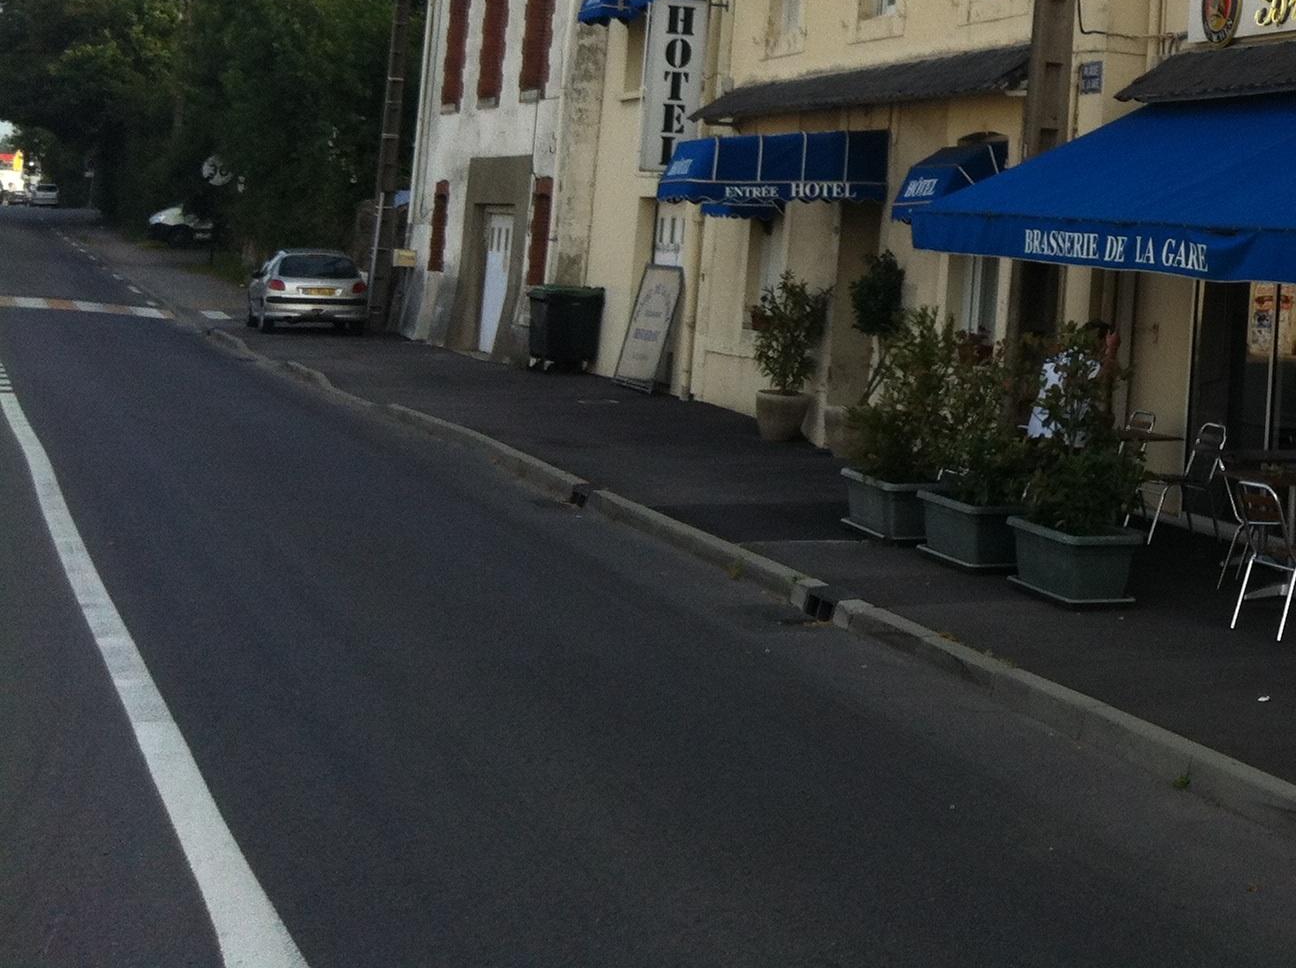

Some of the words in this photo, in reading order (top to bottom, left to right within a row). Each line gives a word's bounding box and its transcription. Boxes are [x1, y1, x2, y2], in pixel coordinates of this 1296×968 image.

[725, 185, 779, 198] ENTRÉE
[1024, 229, 1099, 260] BRASSERIE
[1103, 235, 1127, 263] DE
[1135, 236, 1155, 265] LA
[1162, 238, 1208, 272] GARE
